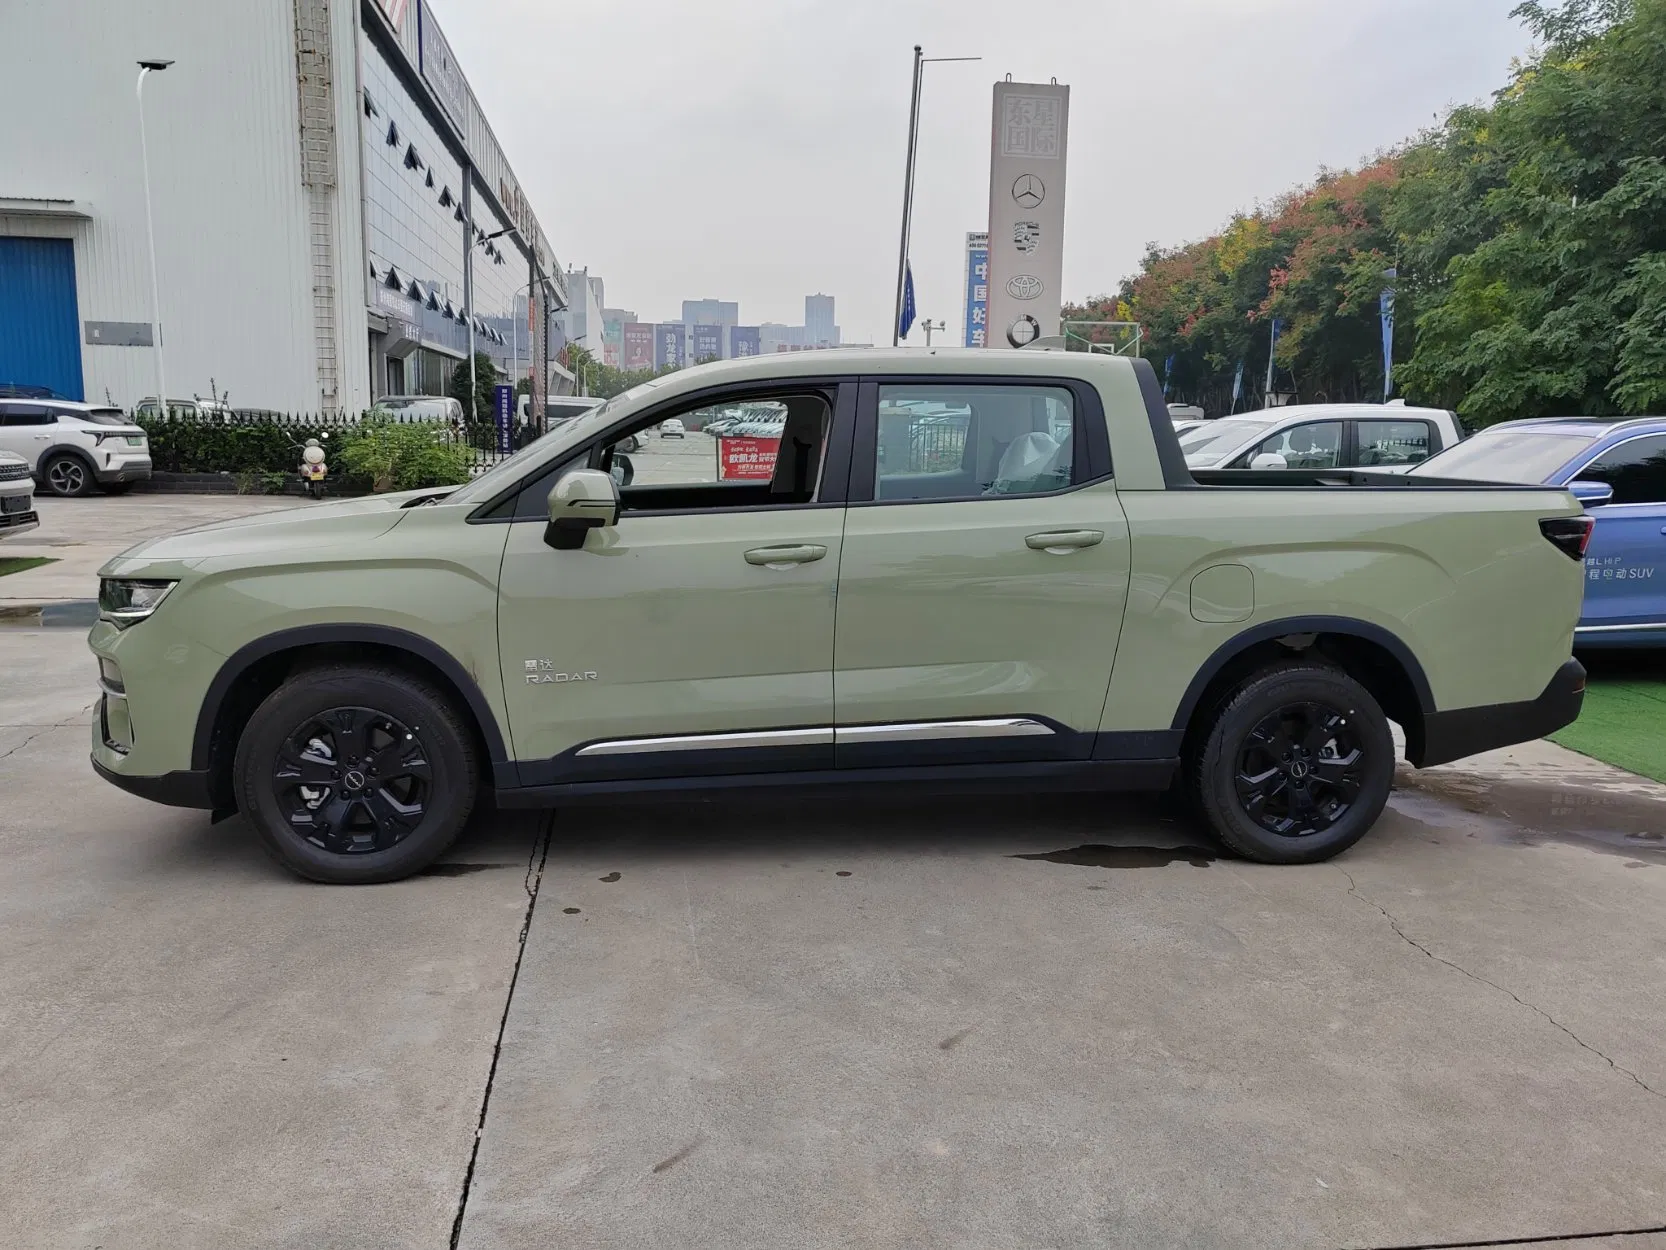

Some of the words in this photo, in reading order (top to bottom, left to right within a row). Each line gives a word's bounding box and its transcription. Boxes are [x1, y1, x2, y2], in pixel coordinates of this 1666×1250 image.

[1585, 567, 1655, 580] 程电动SUV
[524, 658, 554, 672] 雷达
[525, 671, 598, 685] RADAR
